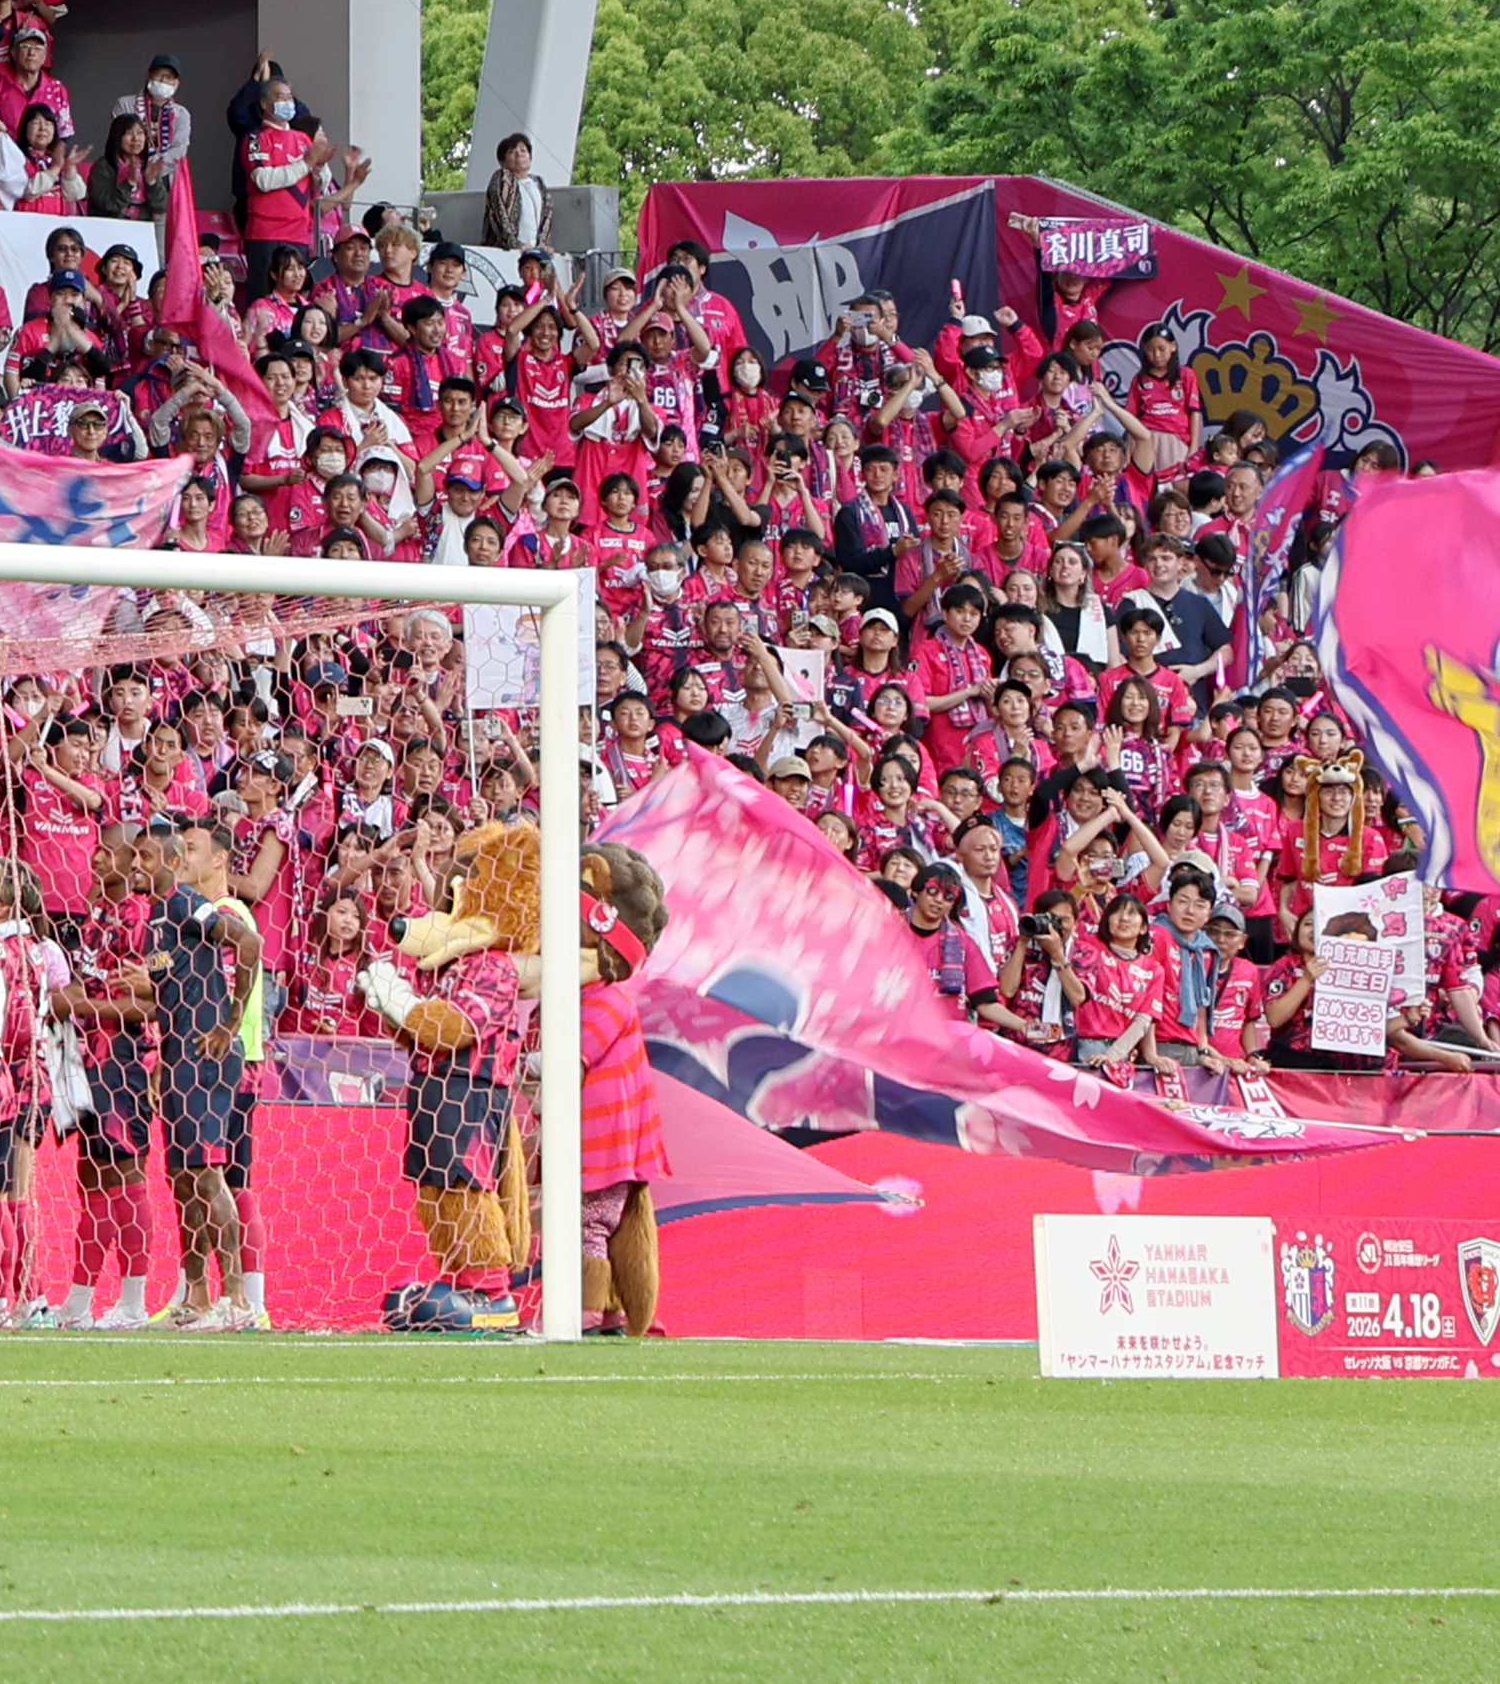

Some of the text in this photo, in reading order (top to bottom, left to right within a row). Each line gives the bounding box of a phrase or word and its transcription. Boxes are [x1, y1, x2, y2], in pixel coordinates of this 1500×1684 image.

[1046, 223, 1151, 267] 香川真司
[653, 386, 677, 409] 66
[1120, 749, 1144, 773] 66
[1315, 995, 1383, 1024] おめでとう
[1144, 1244, 1208, 1263] YANMAR
[1145, 1266, 1231, 1286] HANASAKA
[1146, 1289, 1213, 1308] STADIUM
[1382, 1293, 1442, 1339] 4.18
[1345, 1319, 1381, 1339] 2026
[1343, 1356, 1392, 1372] セレッソ大阪
